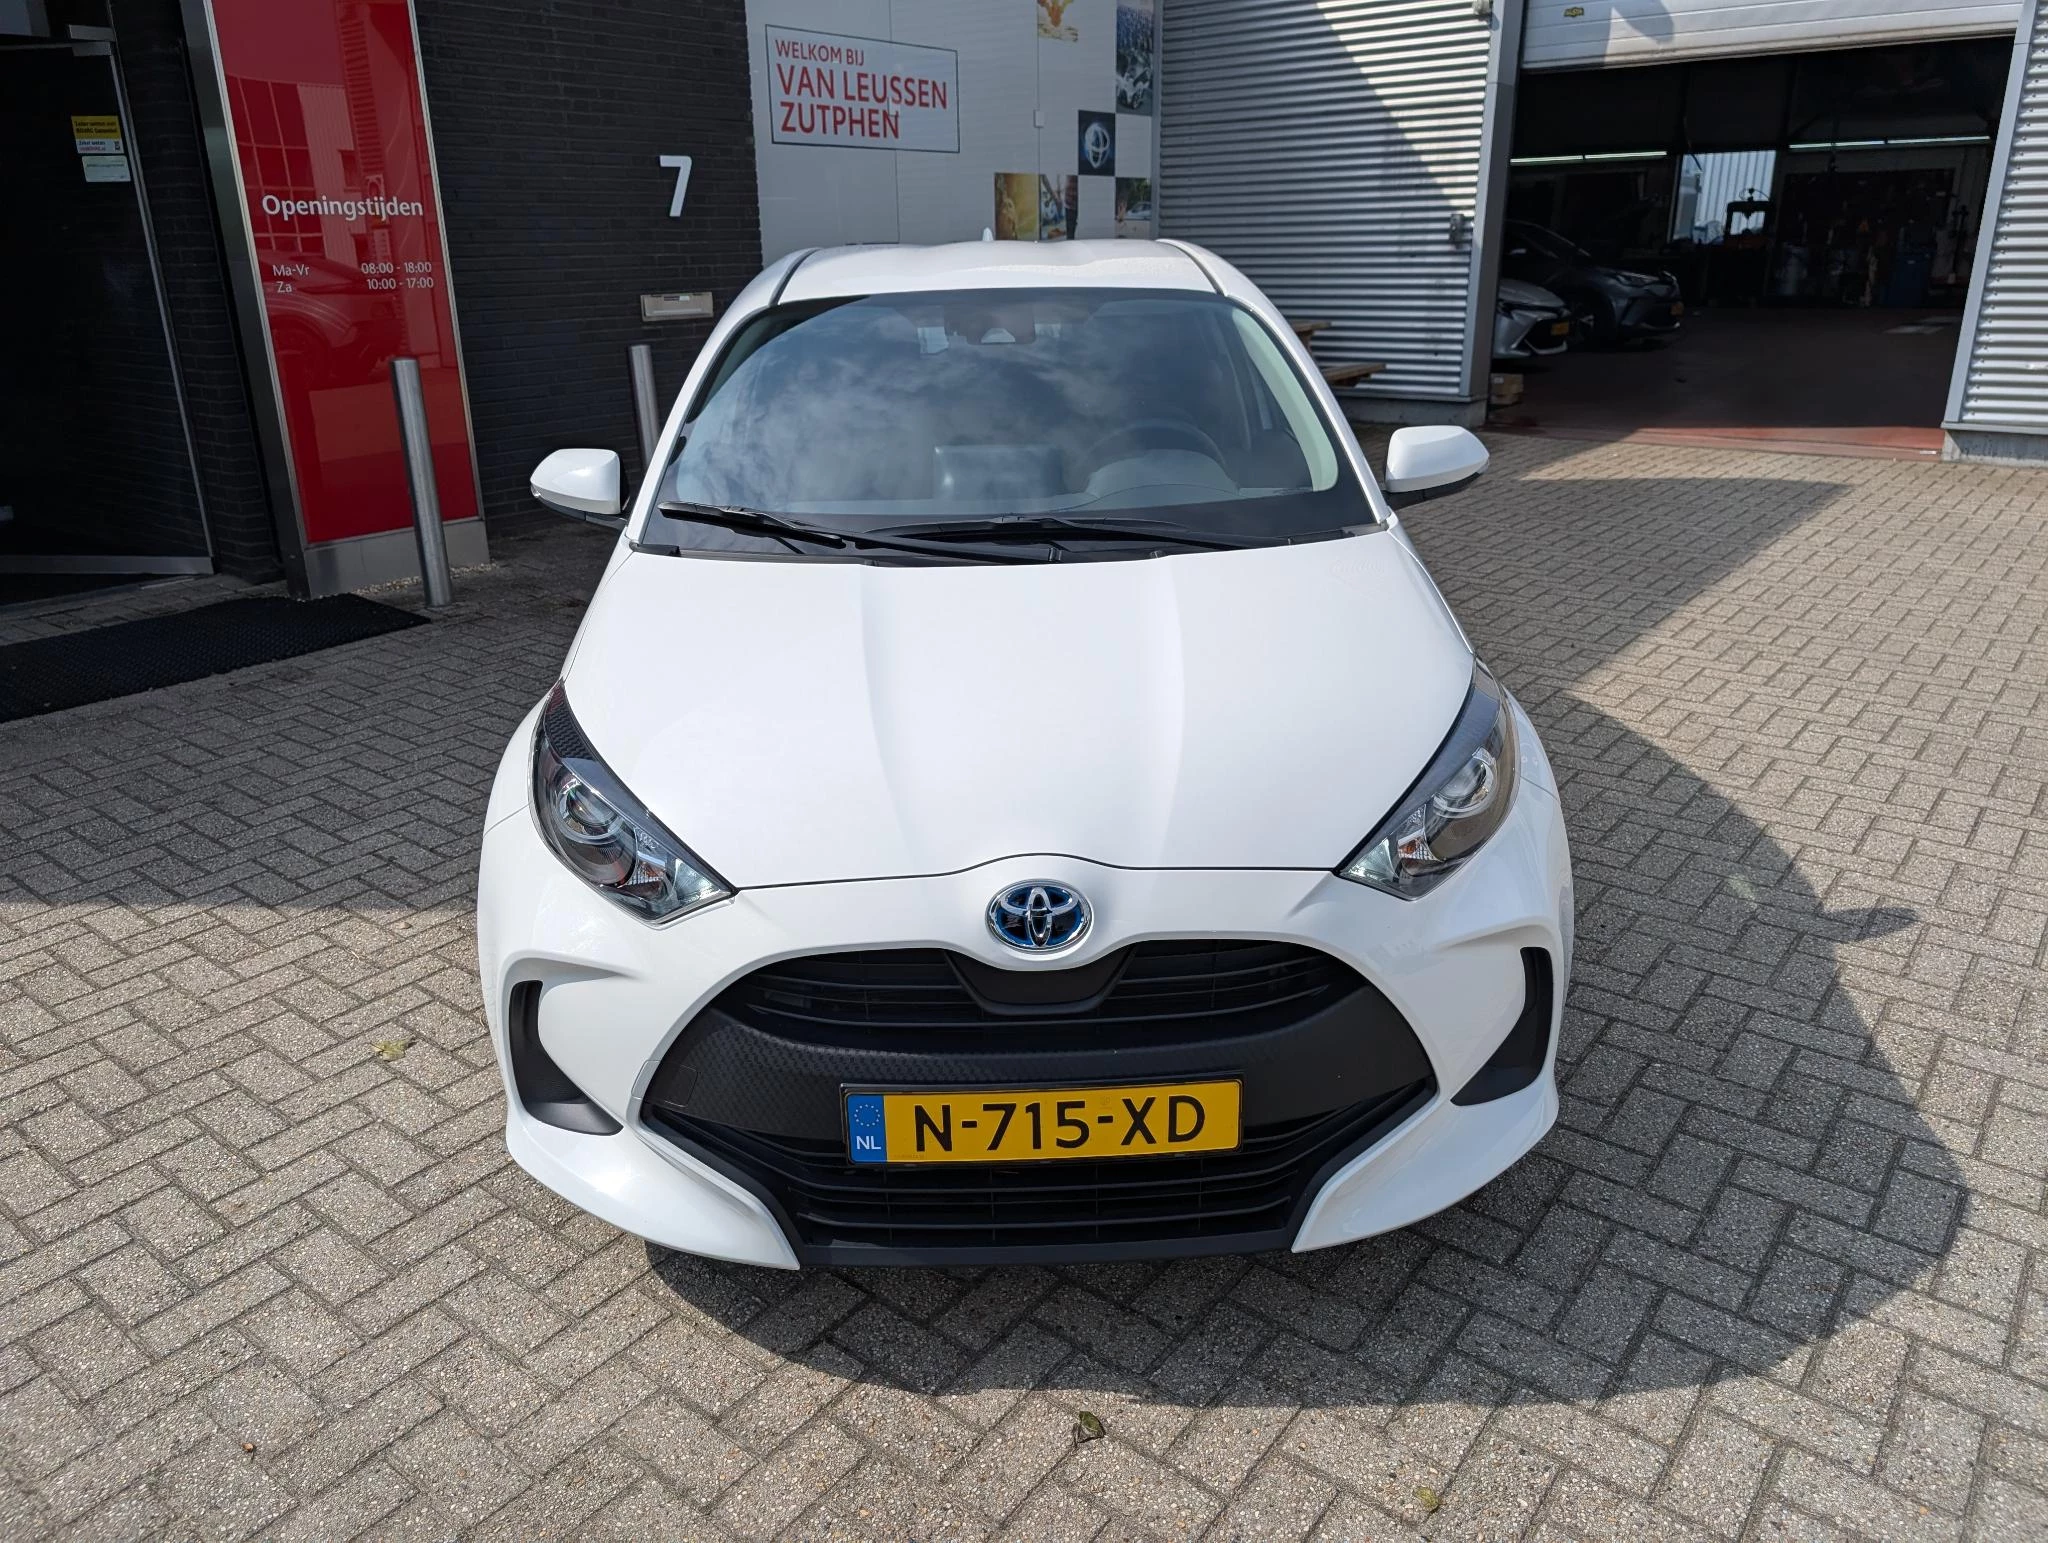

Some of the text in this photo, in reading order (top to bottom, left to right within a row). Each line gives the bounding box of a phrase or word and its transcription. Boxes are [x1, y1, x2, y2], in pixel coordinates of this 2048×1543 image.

[775, 39, 865, 67] WELKOM BIJ
[777, 63, 947, 110] VAN LEUSSEN
[780, 101, 900, 139] ZUTPHEN
[659, 155, 692, 217] 7
[262, 194, 424, 221] Openingstijden
[272, 264, 310, 277] Ma-Vr
[361, 263, 394, 275] 08:00
[404, 262, 432, 274] 18:00
[277, 281, 293, 293] Za
[367, 279, 397, 290] 10:00
[407, 277, 434, 289] 17:00
[914, 1095, 1206, 1152] N-715-XD
[855, 1136, 882, 1150] NL
